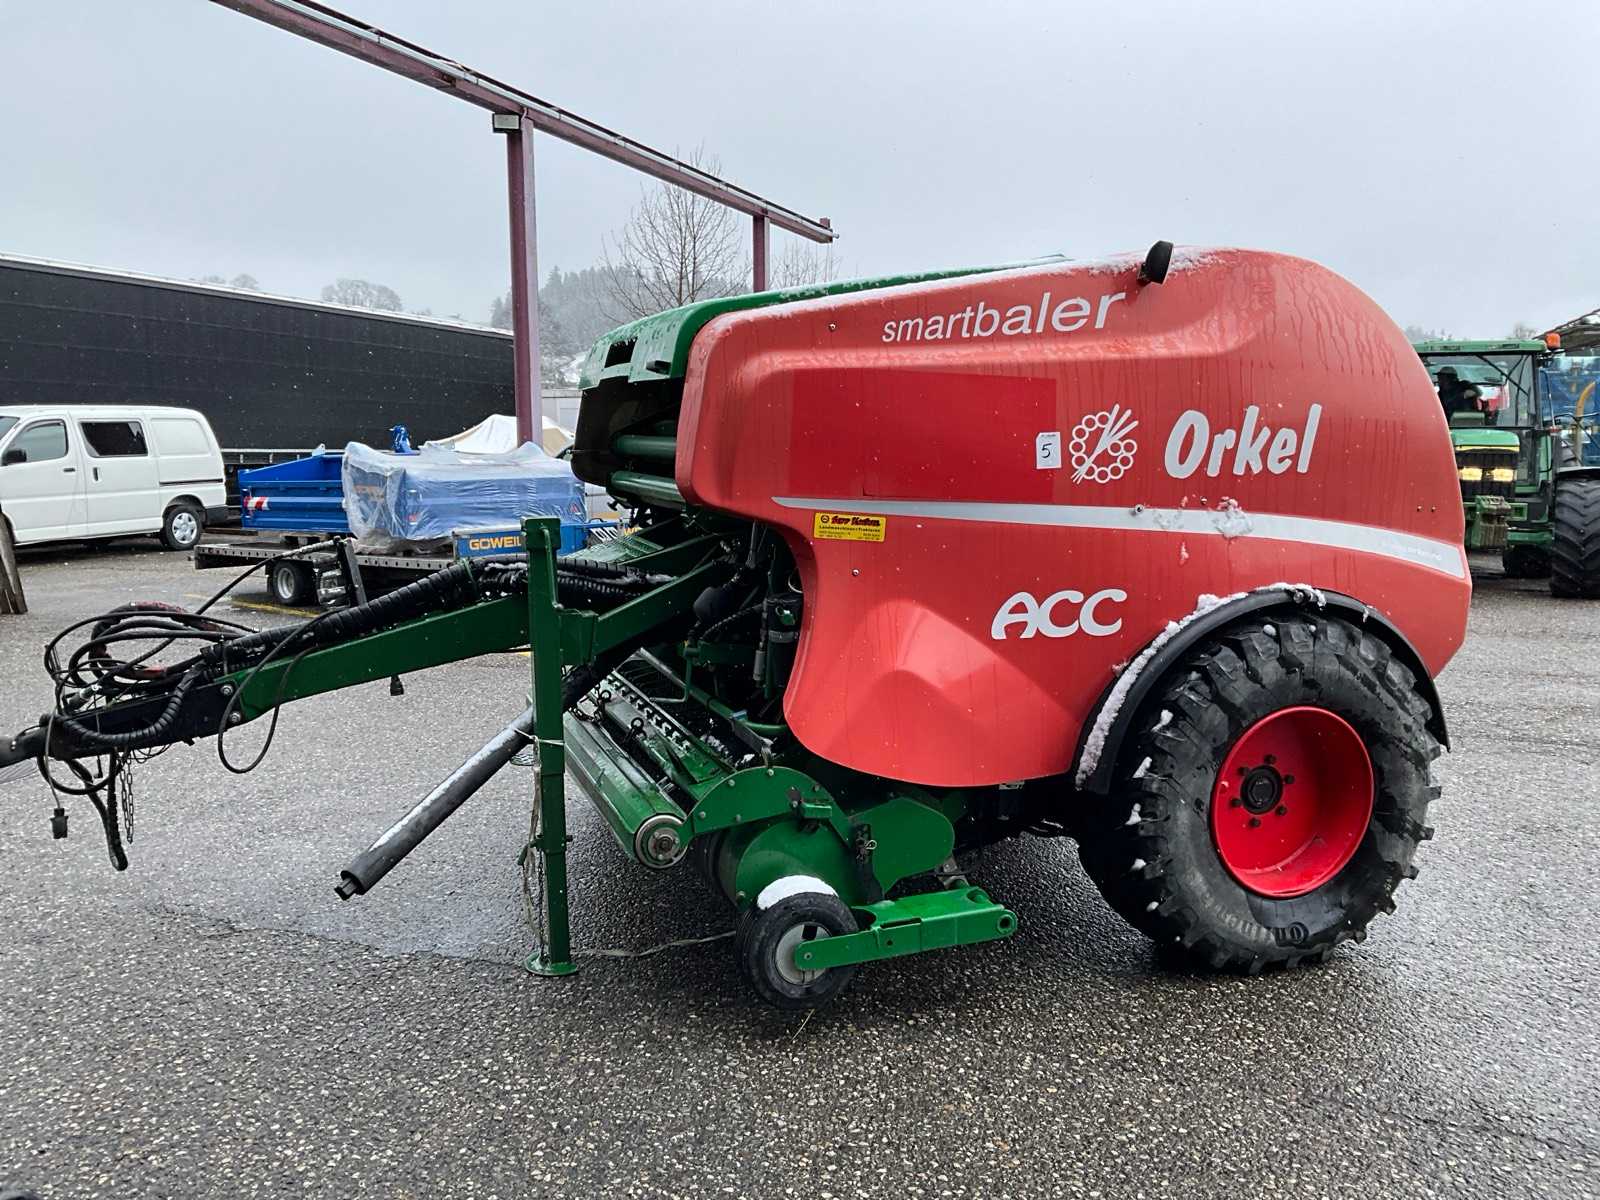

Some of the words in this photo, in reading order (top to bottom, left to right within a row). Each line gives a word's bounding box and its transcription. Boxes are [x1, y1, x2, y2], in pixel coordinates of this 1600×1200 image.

[881, 291, 1127, 343] smartbaler
[1041, 442, 1053, 459] 5
[1164, 403, 1323, 479] Orkel
[991, 588, 1128, 640] ACC
